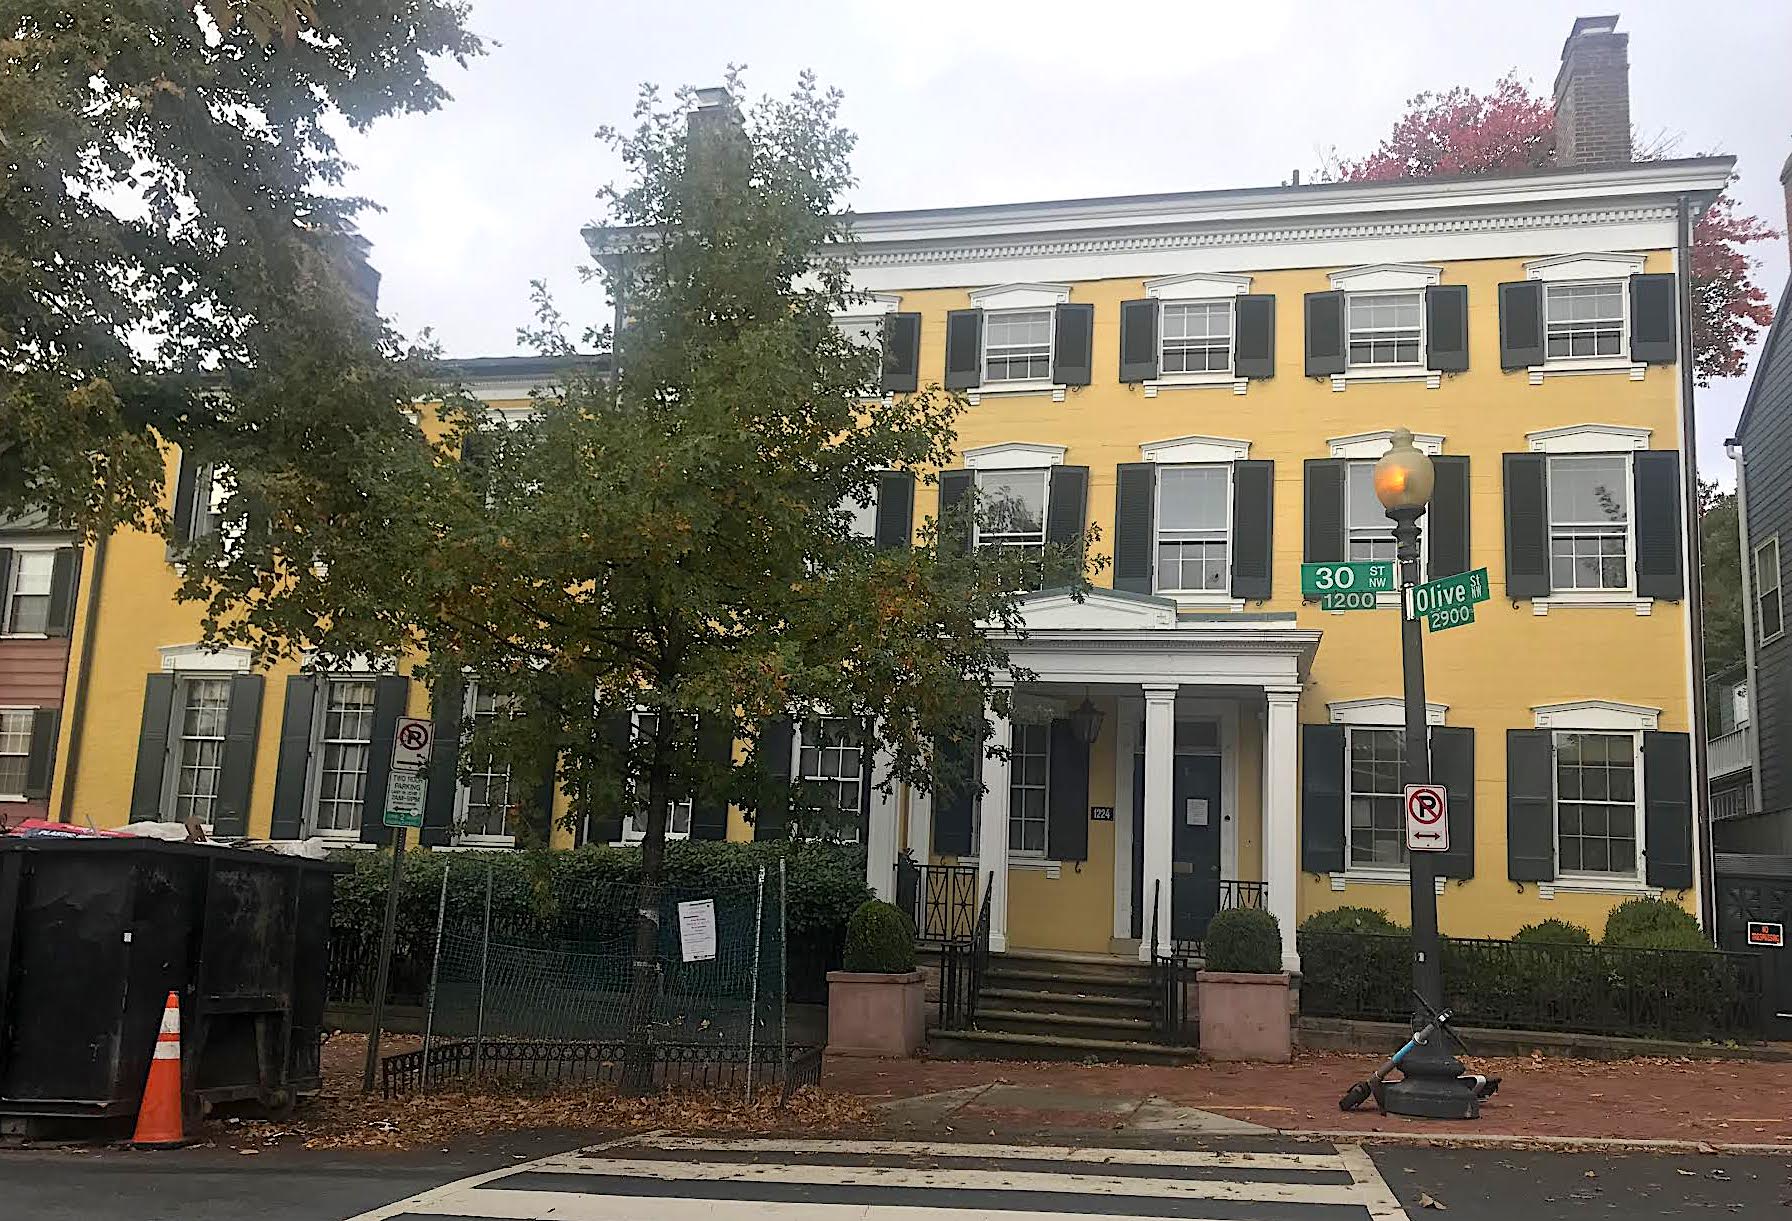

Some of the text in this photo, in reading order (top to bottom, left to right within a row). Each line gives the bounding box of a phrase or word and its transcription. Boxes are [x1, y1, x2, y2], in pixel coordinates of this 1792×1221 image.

[1316, 566, 1385, 589] 30 ST
[1369, 577, 1386, 588] NW
[1417, 574, 1481, 612] Olive St
[1471, 585, 1482, 599] NW
[1324, 592, 1374, 608] 1200
[1432, 606, 1470, 629] 2900
[394, 782, 421, 791] PARKING
[1094, 808, 1110, 818] 1224
